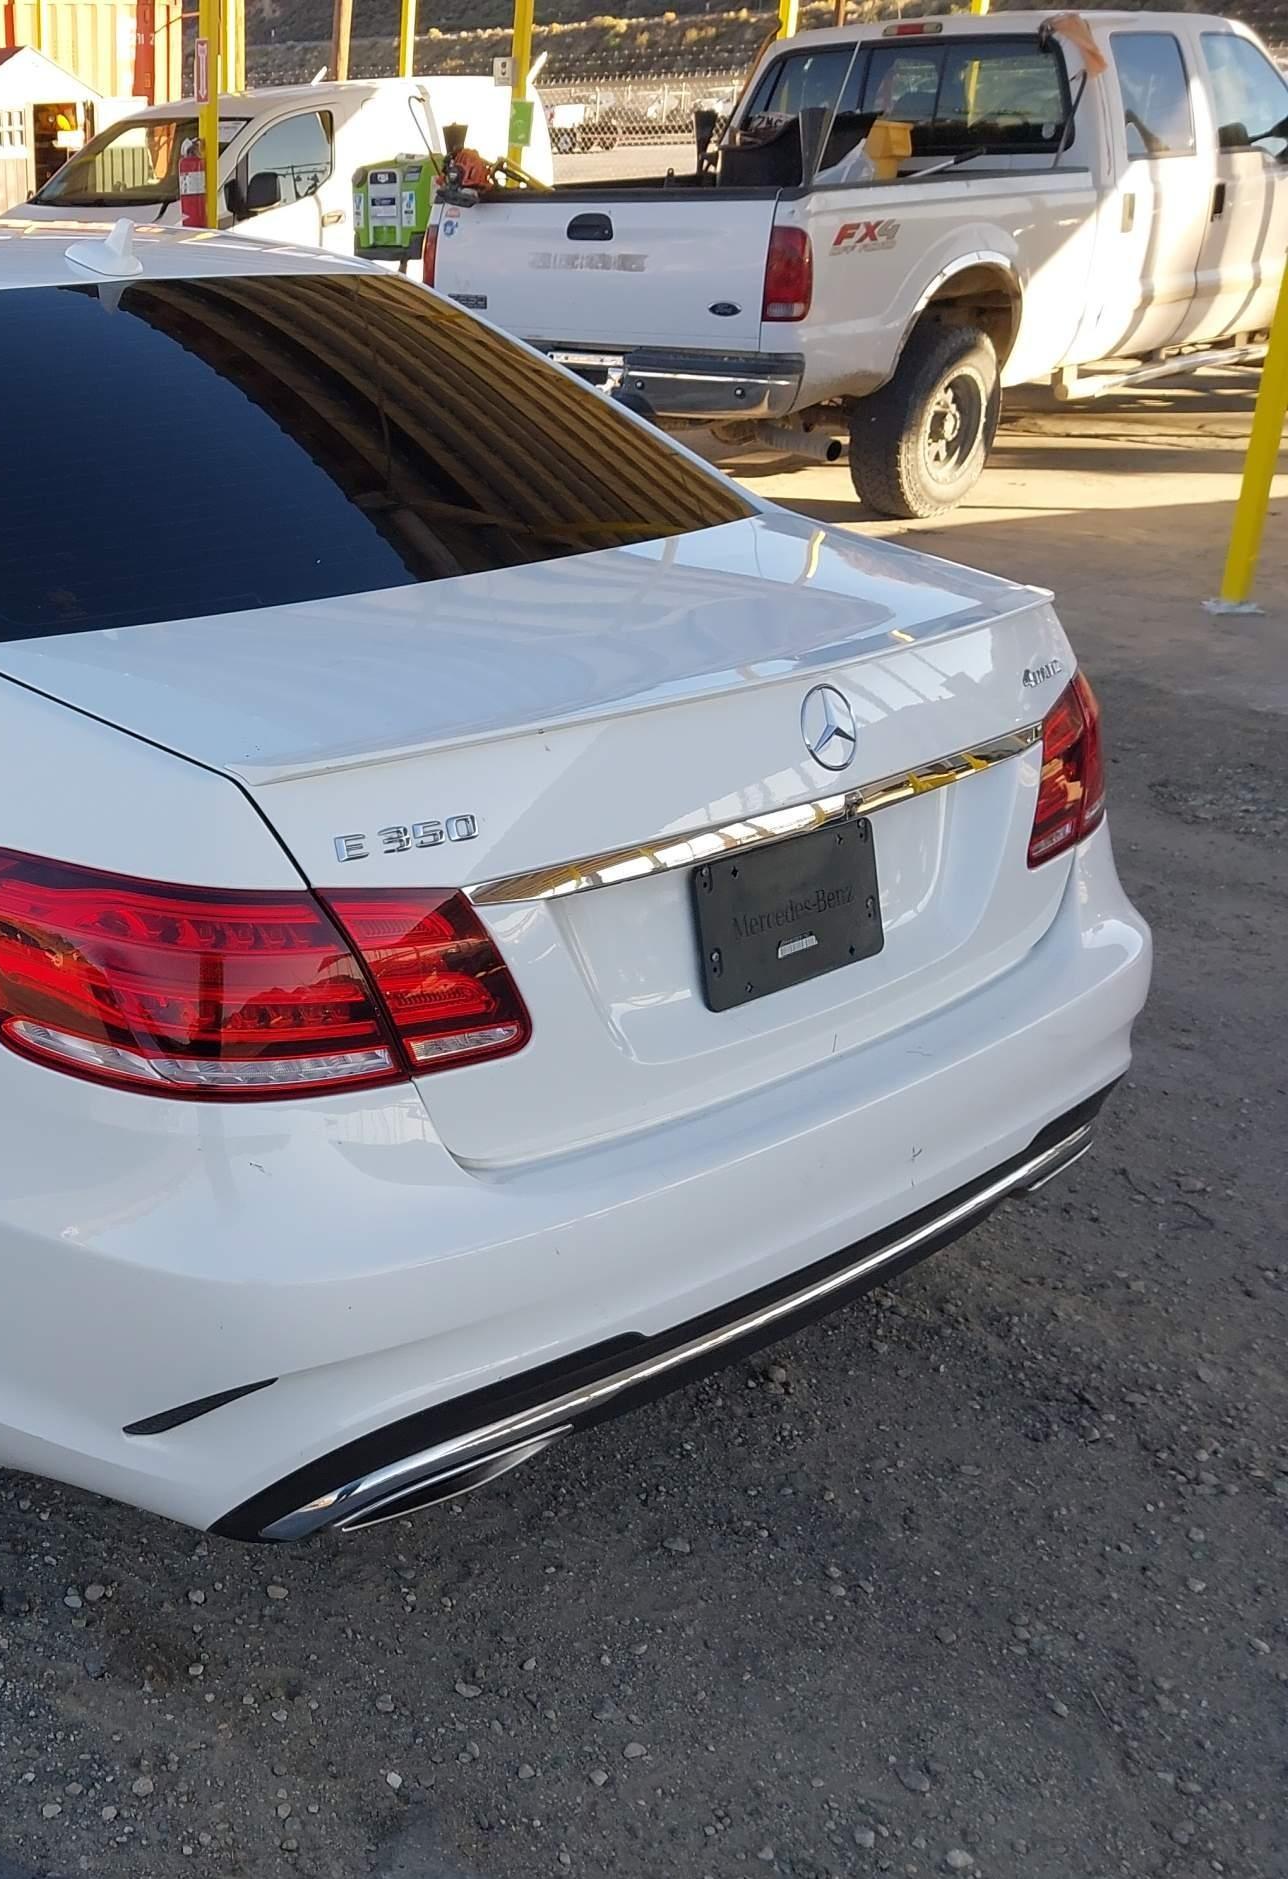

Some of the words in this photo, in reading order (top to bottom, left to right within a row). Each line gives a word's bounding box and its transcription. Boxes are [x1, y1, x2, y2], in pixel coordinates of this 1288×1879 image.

[832, 218, 901, 246] FX4
[333, 833, 369, 863] E
[377, 813, 480, 854] 350
[731, 885, 855, 940] Mercedes-Benz
